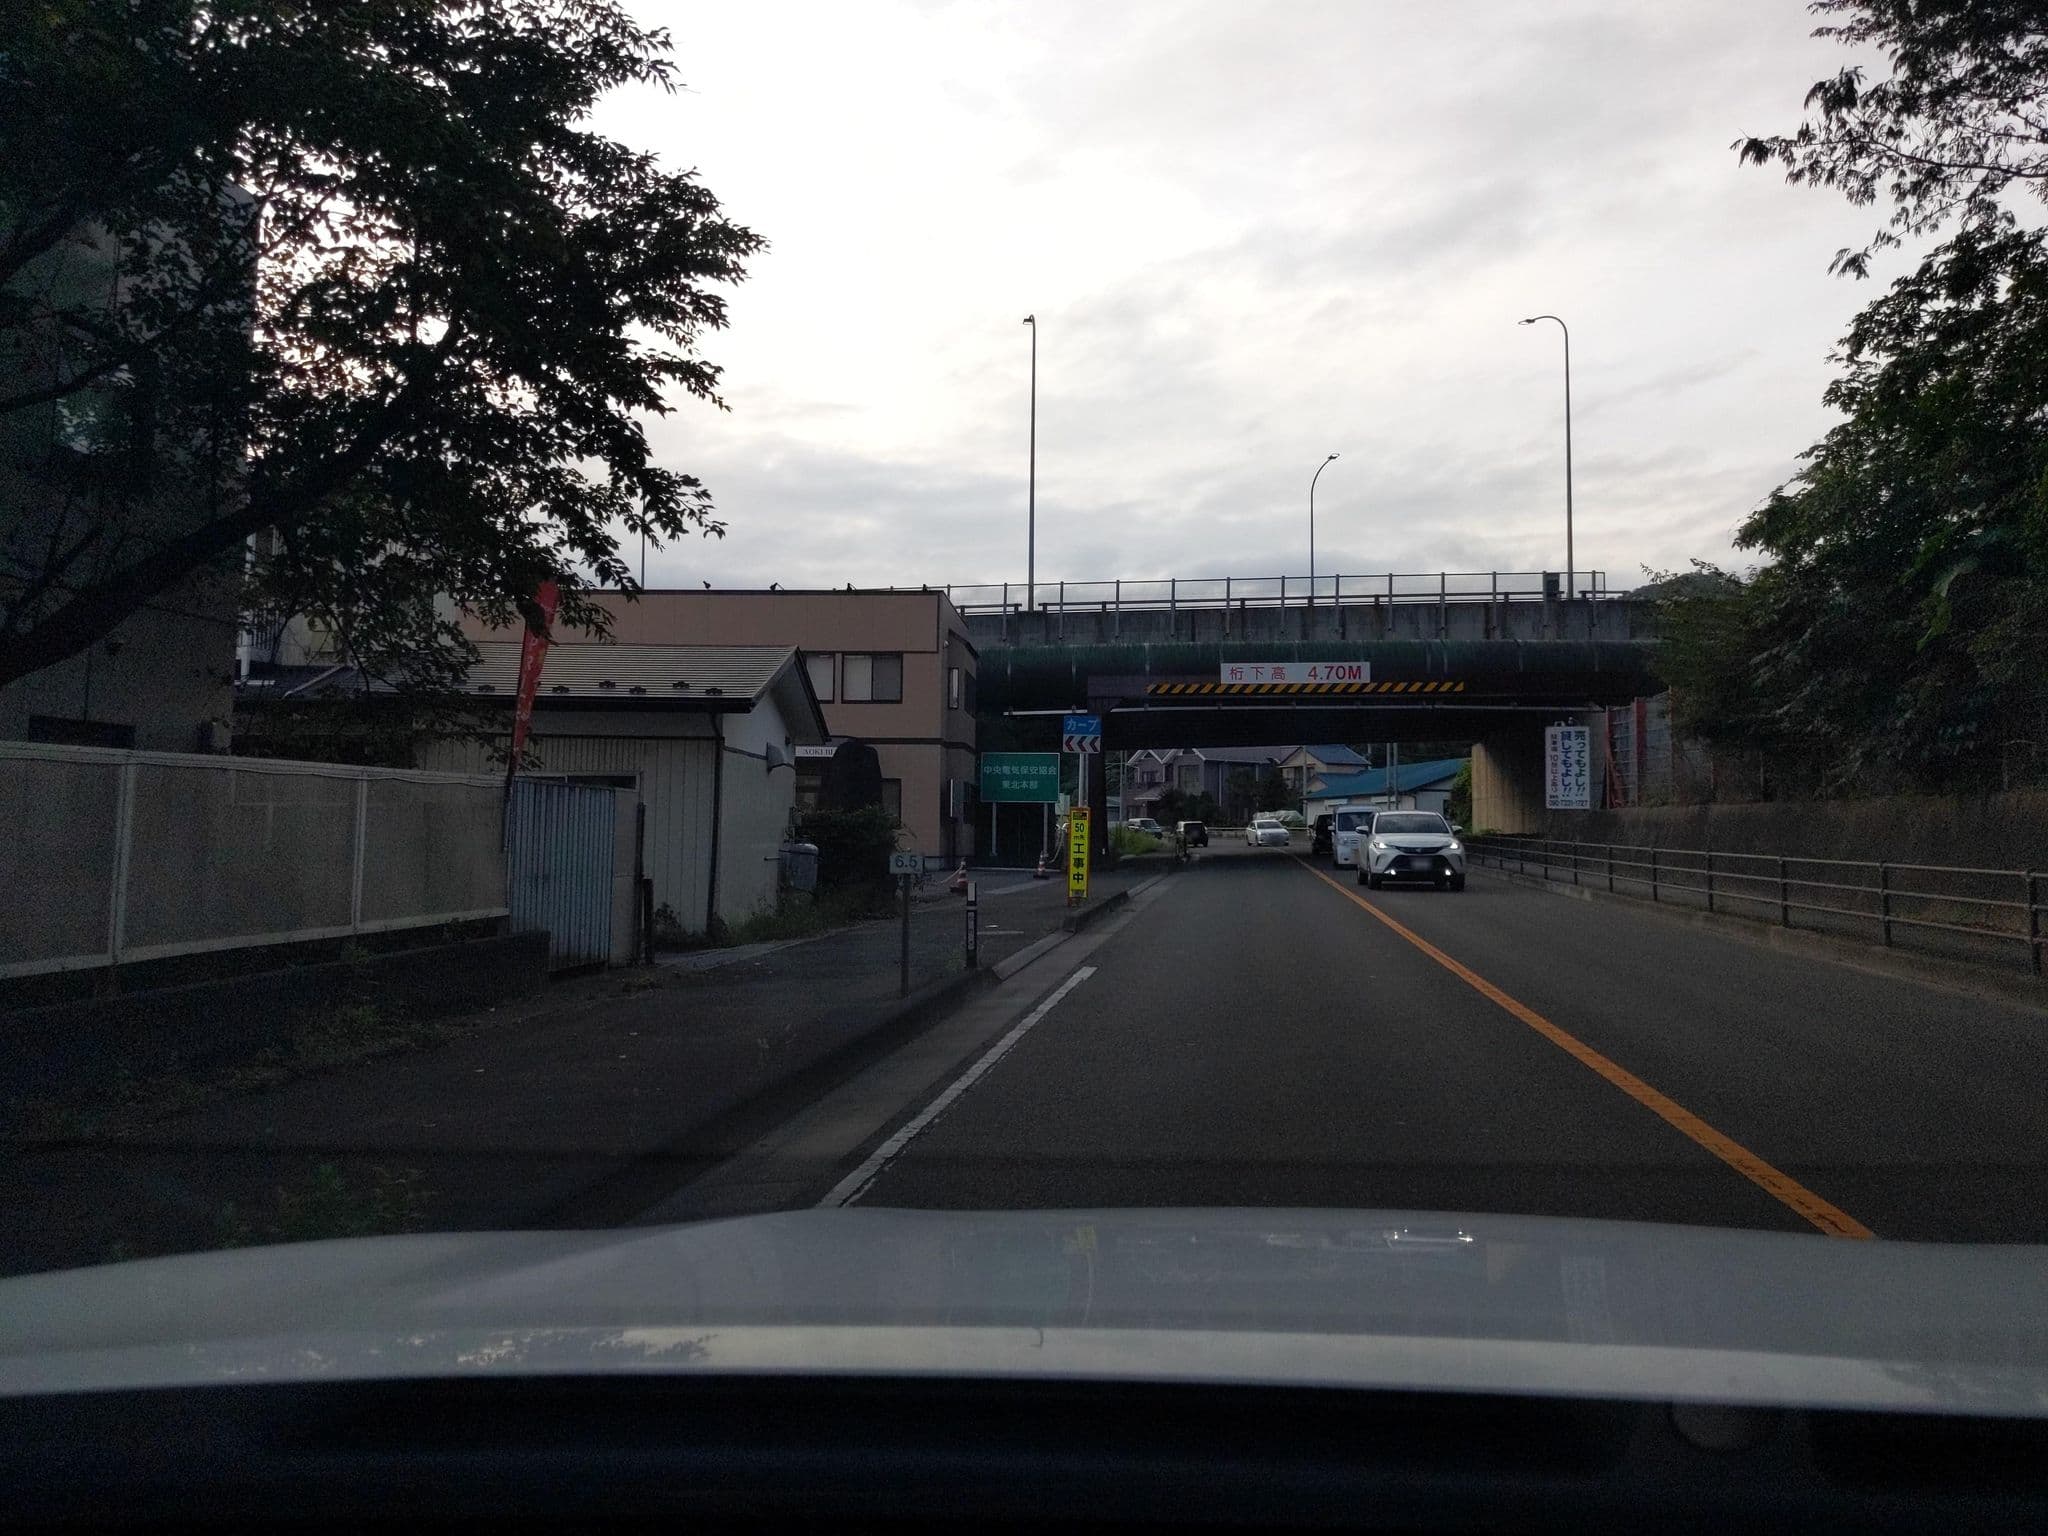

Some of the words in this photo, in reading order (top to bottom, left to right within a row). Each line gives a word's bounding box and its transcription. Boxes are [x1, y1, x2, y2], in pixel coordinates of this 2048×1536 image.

[1230, 666, 1285, 680] 桁下高
[1308, 665, 1362, 680] 4.70M
[1075, 823, 1085, 832] 50
[1073, 843, 1085, 884] 工事中
